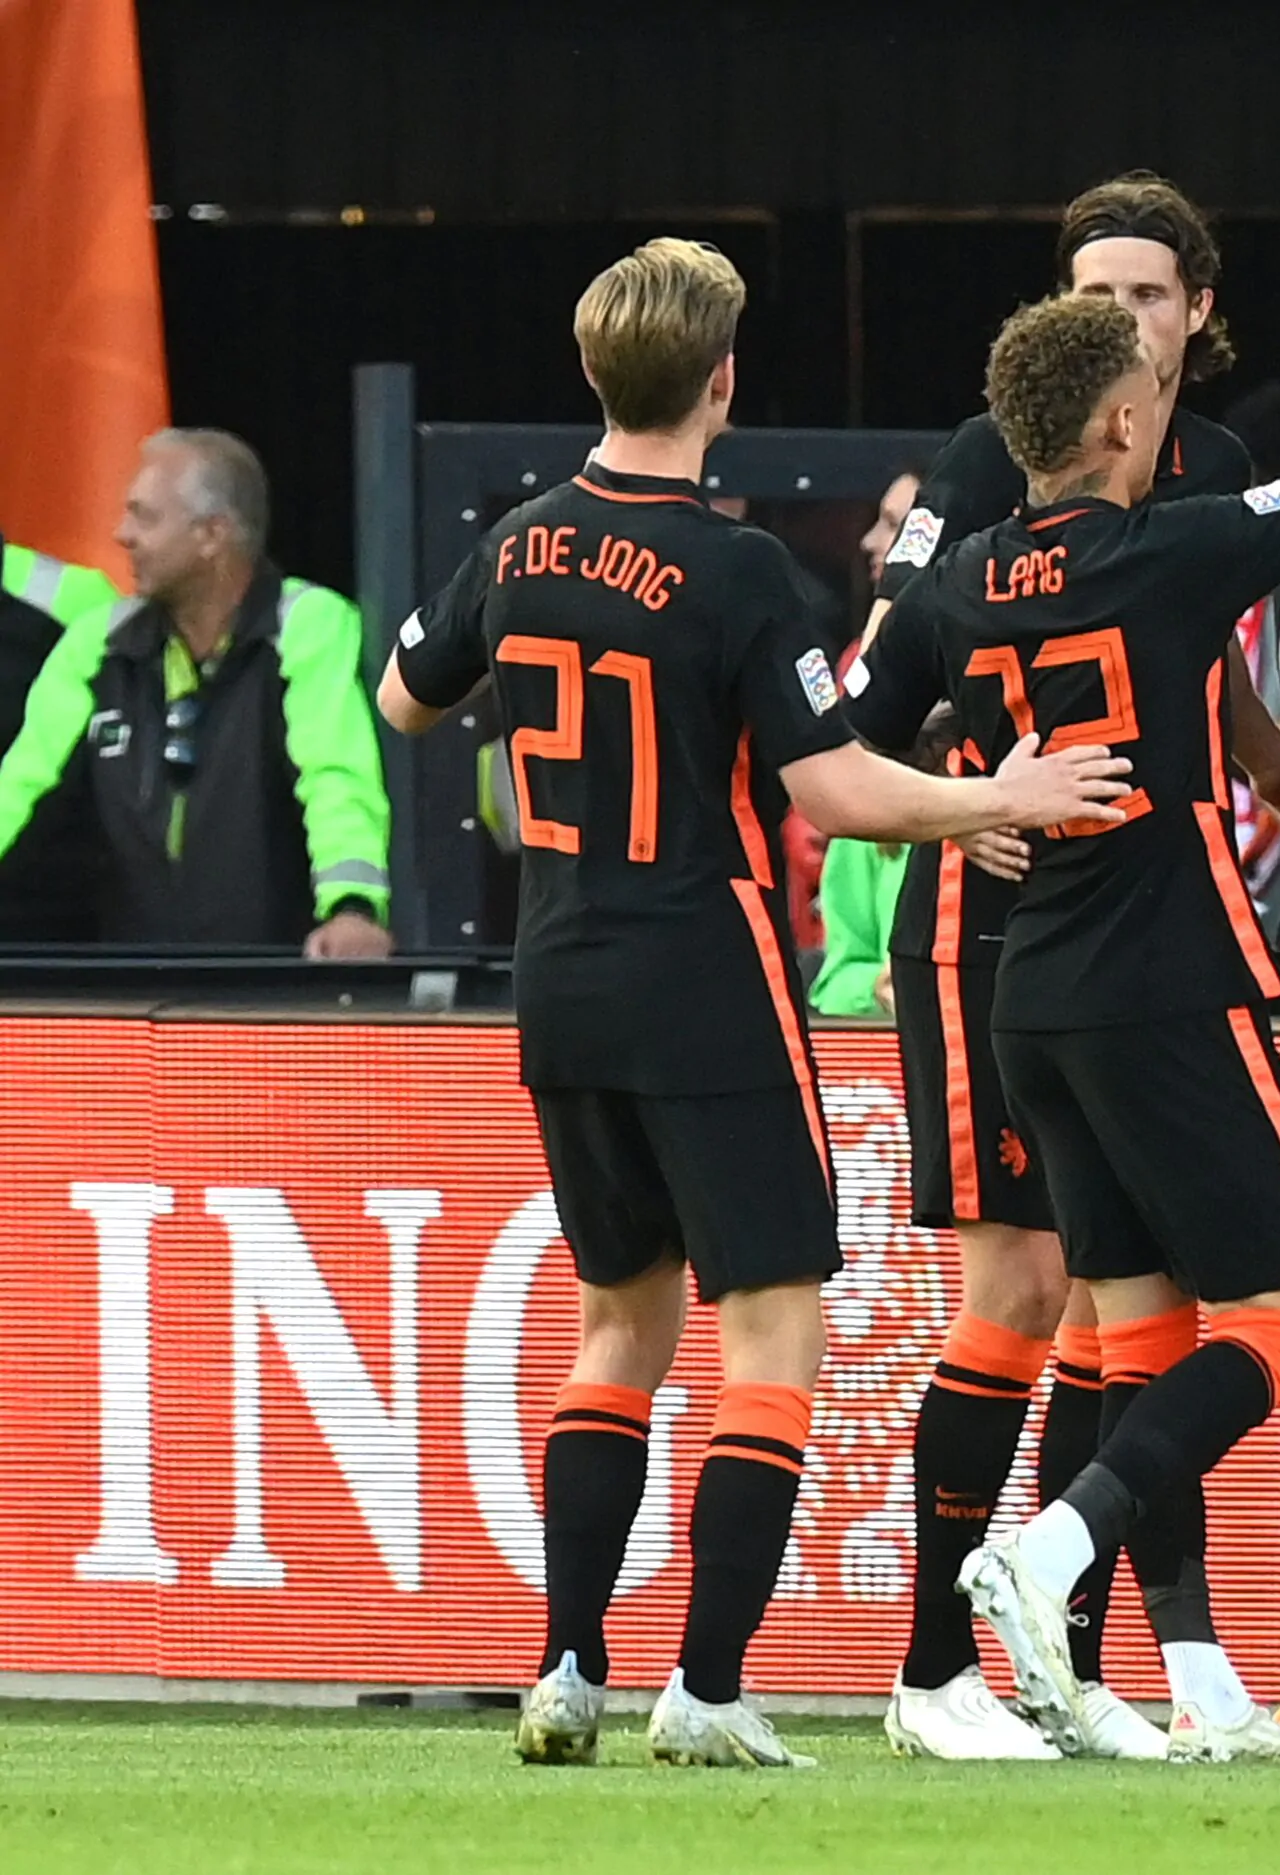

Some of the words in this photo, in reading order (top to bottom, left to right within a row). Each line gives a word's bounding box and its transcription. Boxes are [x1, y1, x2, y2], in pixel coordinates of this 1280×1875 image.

[580, 534, 684, 611] JONG
[985, 545, 1067, 602] LANG
[495, 634, 659, 863] 21
[70, 1182, 687, 1595] ING
